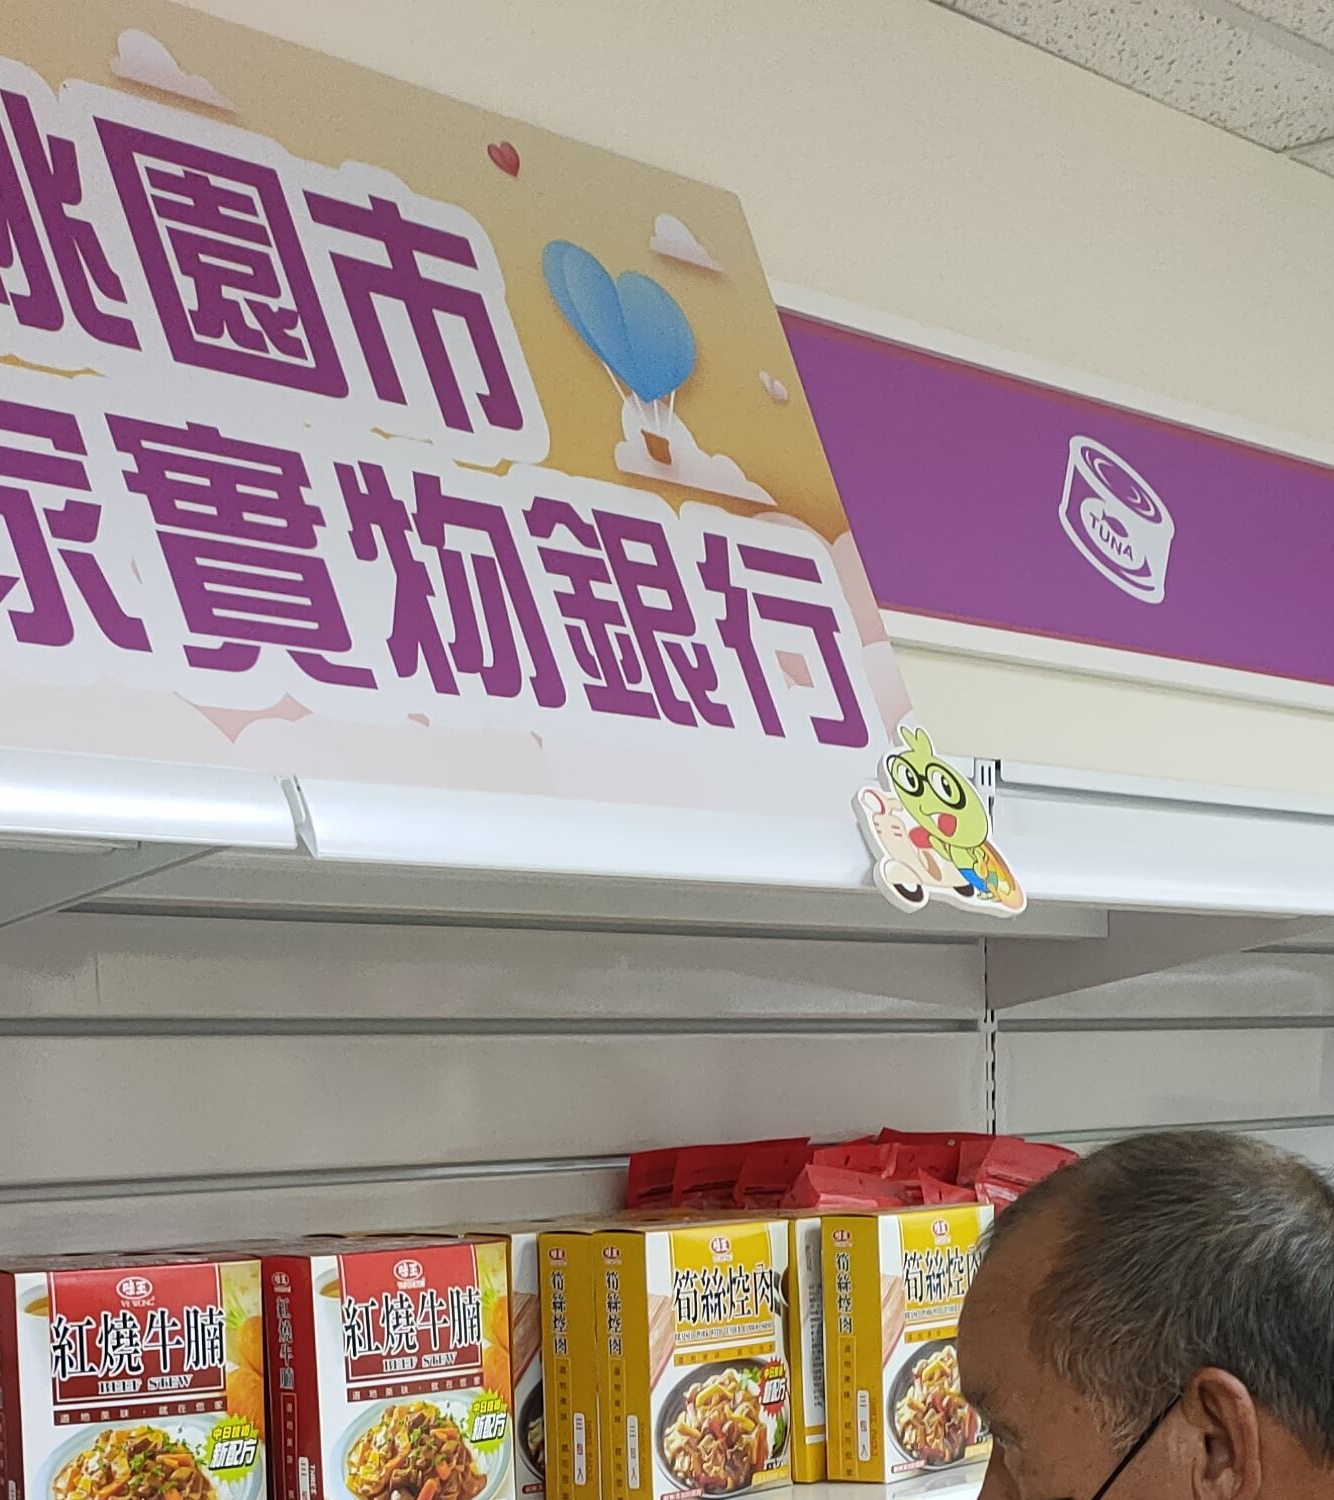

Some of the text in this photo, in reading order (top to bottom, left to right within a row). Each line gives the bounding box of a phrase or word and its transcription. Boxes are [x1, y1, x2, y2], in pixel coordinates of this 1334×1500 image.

[1089, 511, 1134, 562] TUNA
[122, 1280, 148, 1297] 味王
[344, 1287, 484, 1358] 紅燒牛腩
[51, 1306, 226, 1380] 紅燒牛腩
[383, 1356, 418, 1372] BEEF
[98, 1374, 193, 1395] BEEF STEW
[471, 1413, 507, 1444] 新配方
[208, 1438, 258, 1471] 新配方
